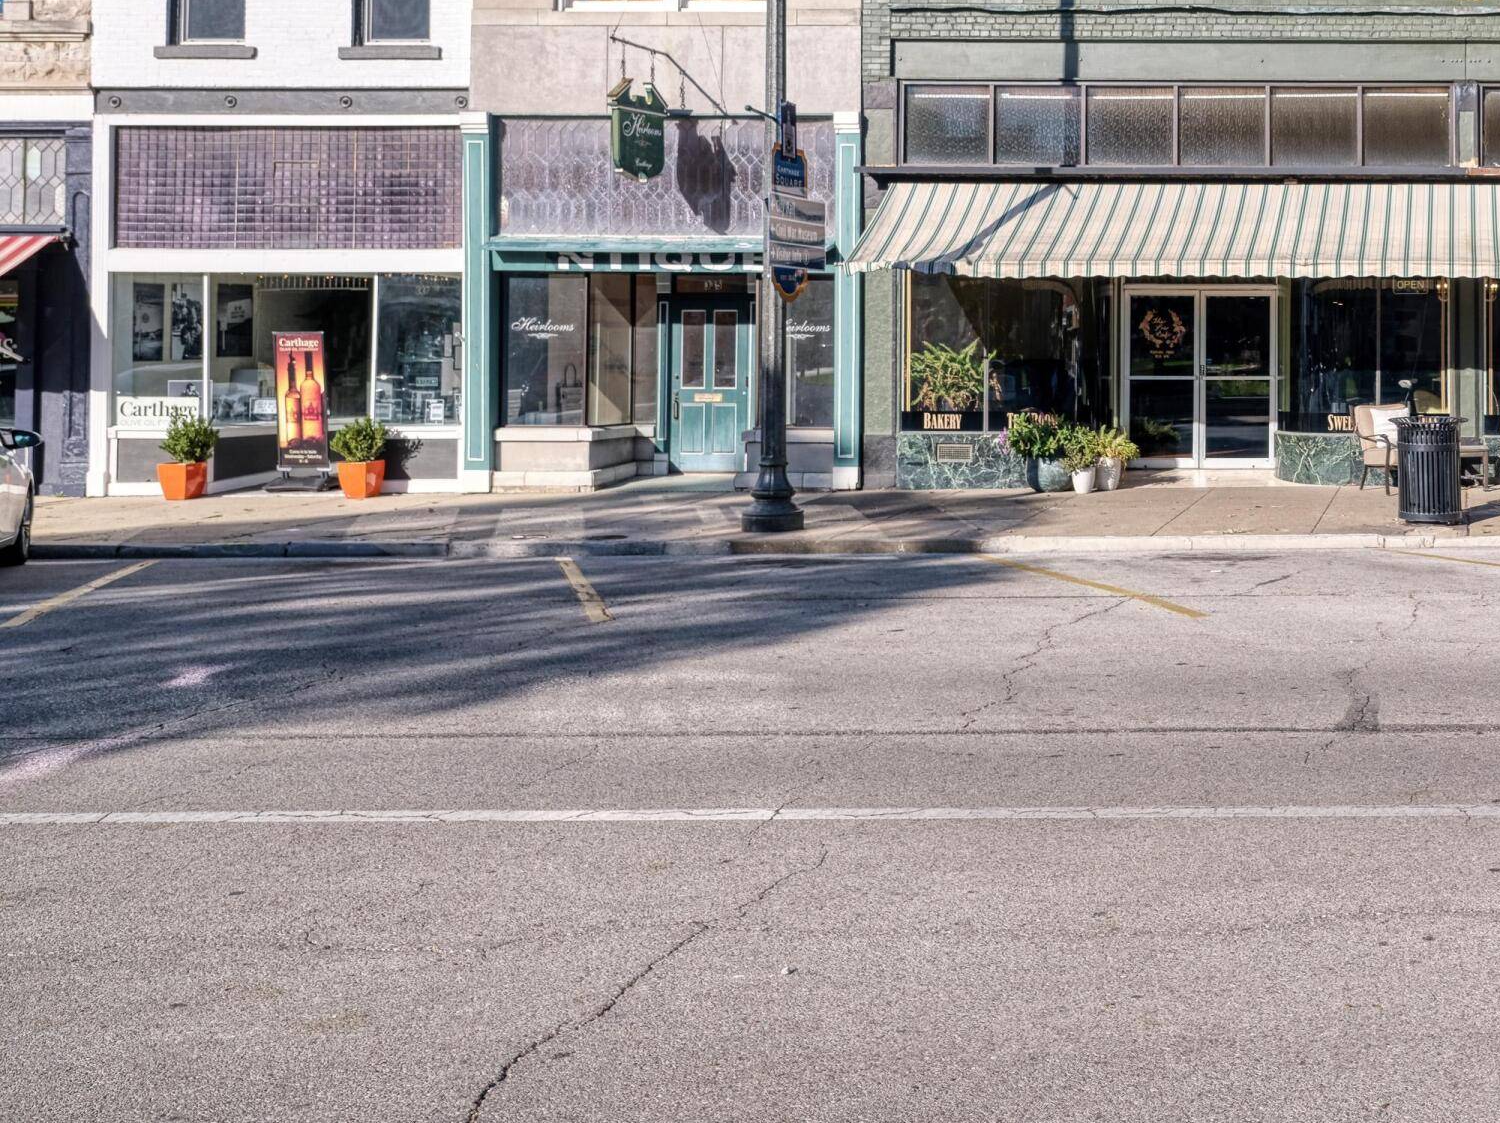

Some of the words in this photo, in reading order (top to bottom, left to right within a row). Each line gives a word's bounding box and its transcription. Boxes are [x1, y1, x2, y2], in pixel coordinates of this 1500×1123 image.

[775, 174, 803, 188] SQUARE
[787, 225, 797, 238] War
[798, 227, 818, 242] Museum
[1397, 280, 1425, 290] OPEN
[511, 316, 576, 332] Heirlooms
[278, 337, 319, 348] Carthage
[120, 400, 198, 418] Carthage
[923, 412, 962, 430] BAKERY
[1327, 414, 1354, 431] SWE
